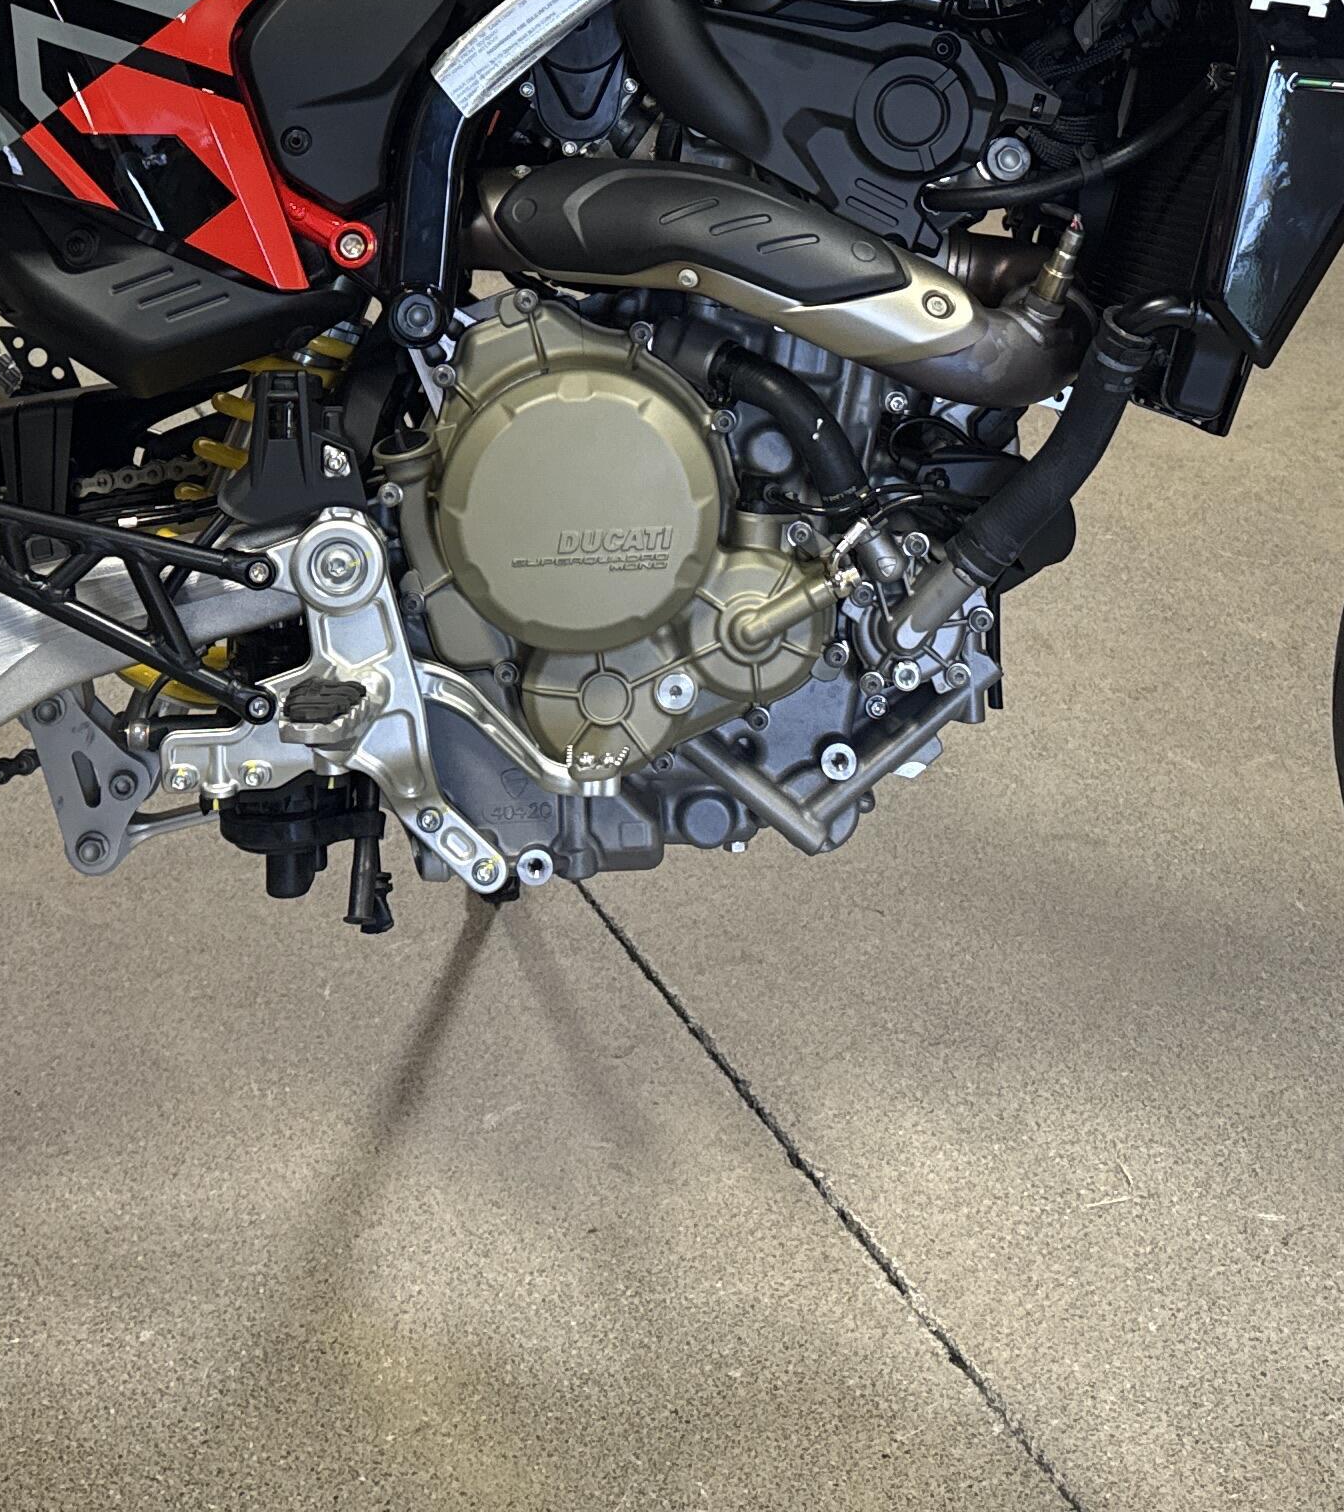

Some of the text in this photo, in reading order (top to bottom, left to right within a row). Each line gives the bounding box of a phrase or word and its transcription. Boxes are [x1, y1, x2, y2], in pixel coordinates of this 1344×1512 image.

[557, 525, 674, 555] DUCATI
[511, 553, 670, 569] SUPERQUADRO
[609, 561, 669, 573] MONO
